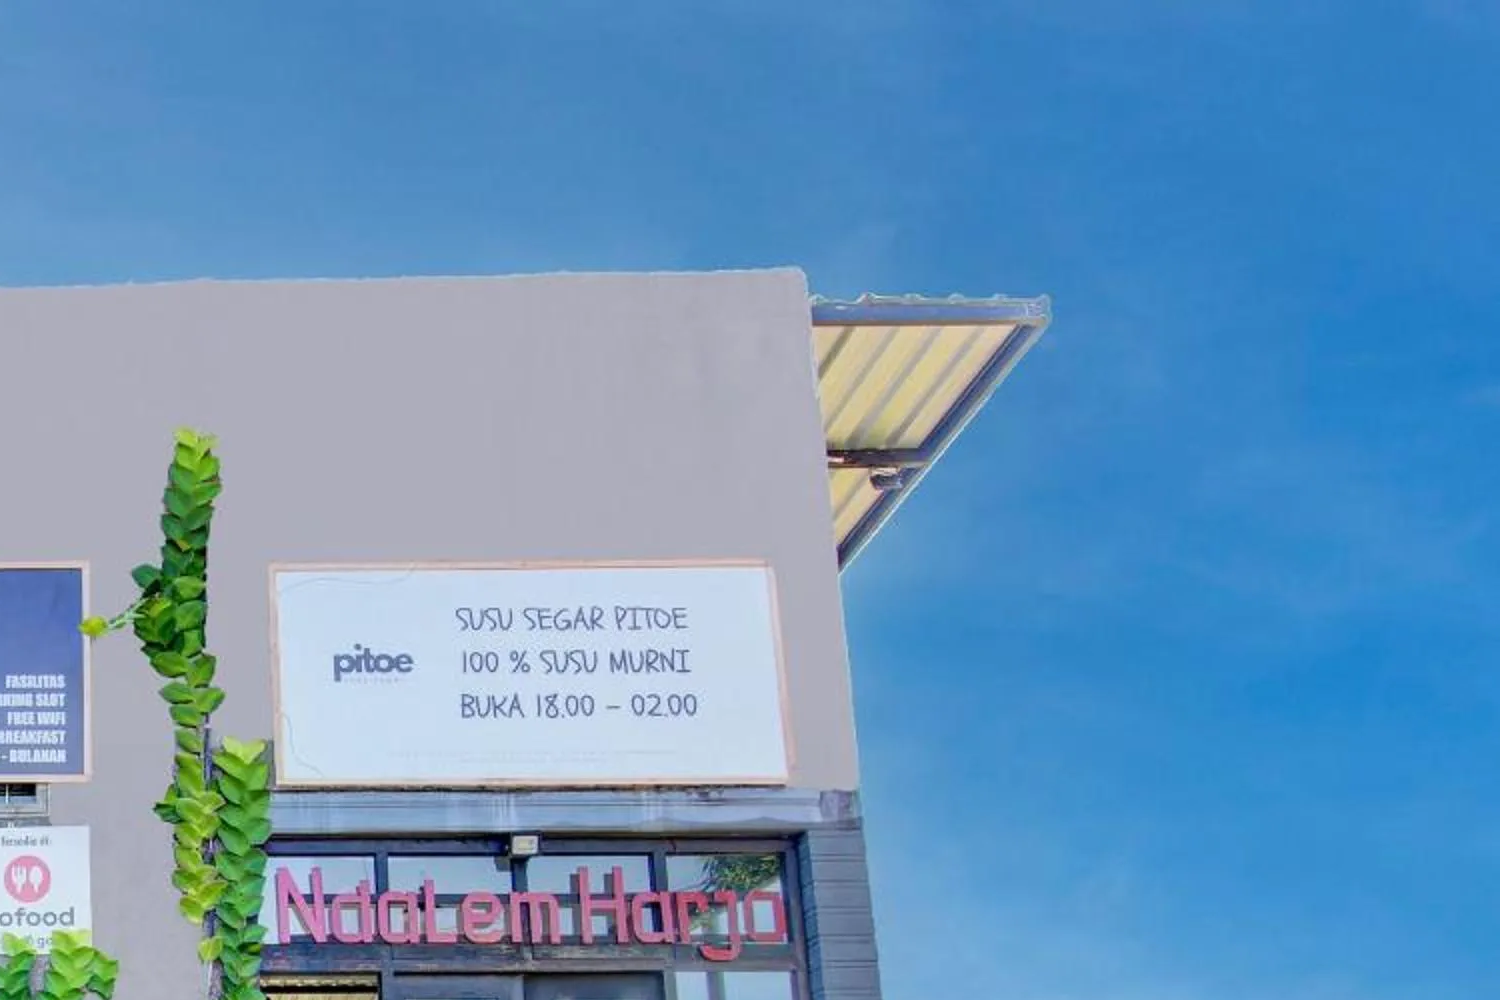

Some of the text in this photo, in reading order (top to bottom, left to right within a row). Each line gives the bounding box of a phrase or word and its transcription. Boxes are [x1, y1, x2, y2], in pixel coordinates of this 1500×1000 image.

[455, 606, 689, 631] SUSU SEGAR PITOE
[333, 643, 415, 682] pitoe
[462, 648, 691, 674] 100 % SUSU MURNI
[35, 693, 66, 707] SLOT
[460, 693, 525, 718] BUKA
[536, 694, 595, 719] 18.00
[631, 694, 697, 717] 02.00
[7, 711, 66, 725] FREE WIFI
[578, 865, 788, 961] Harjo
